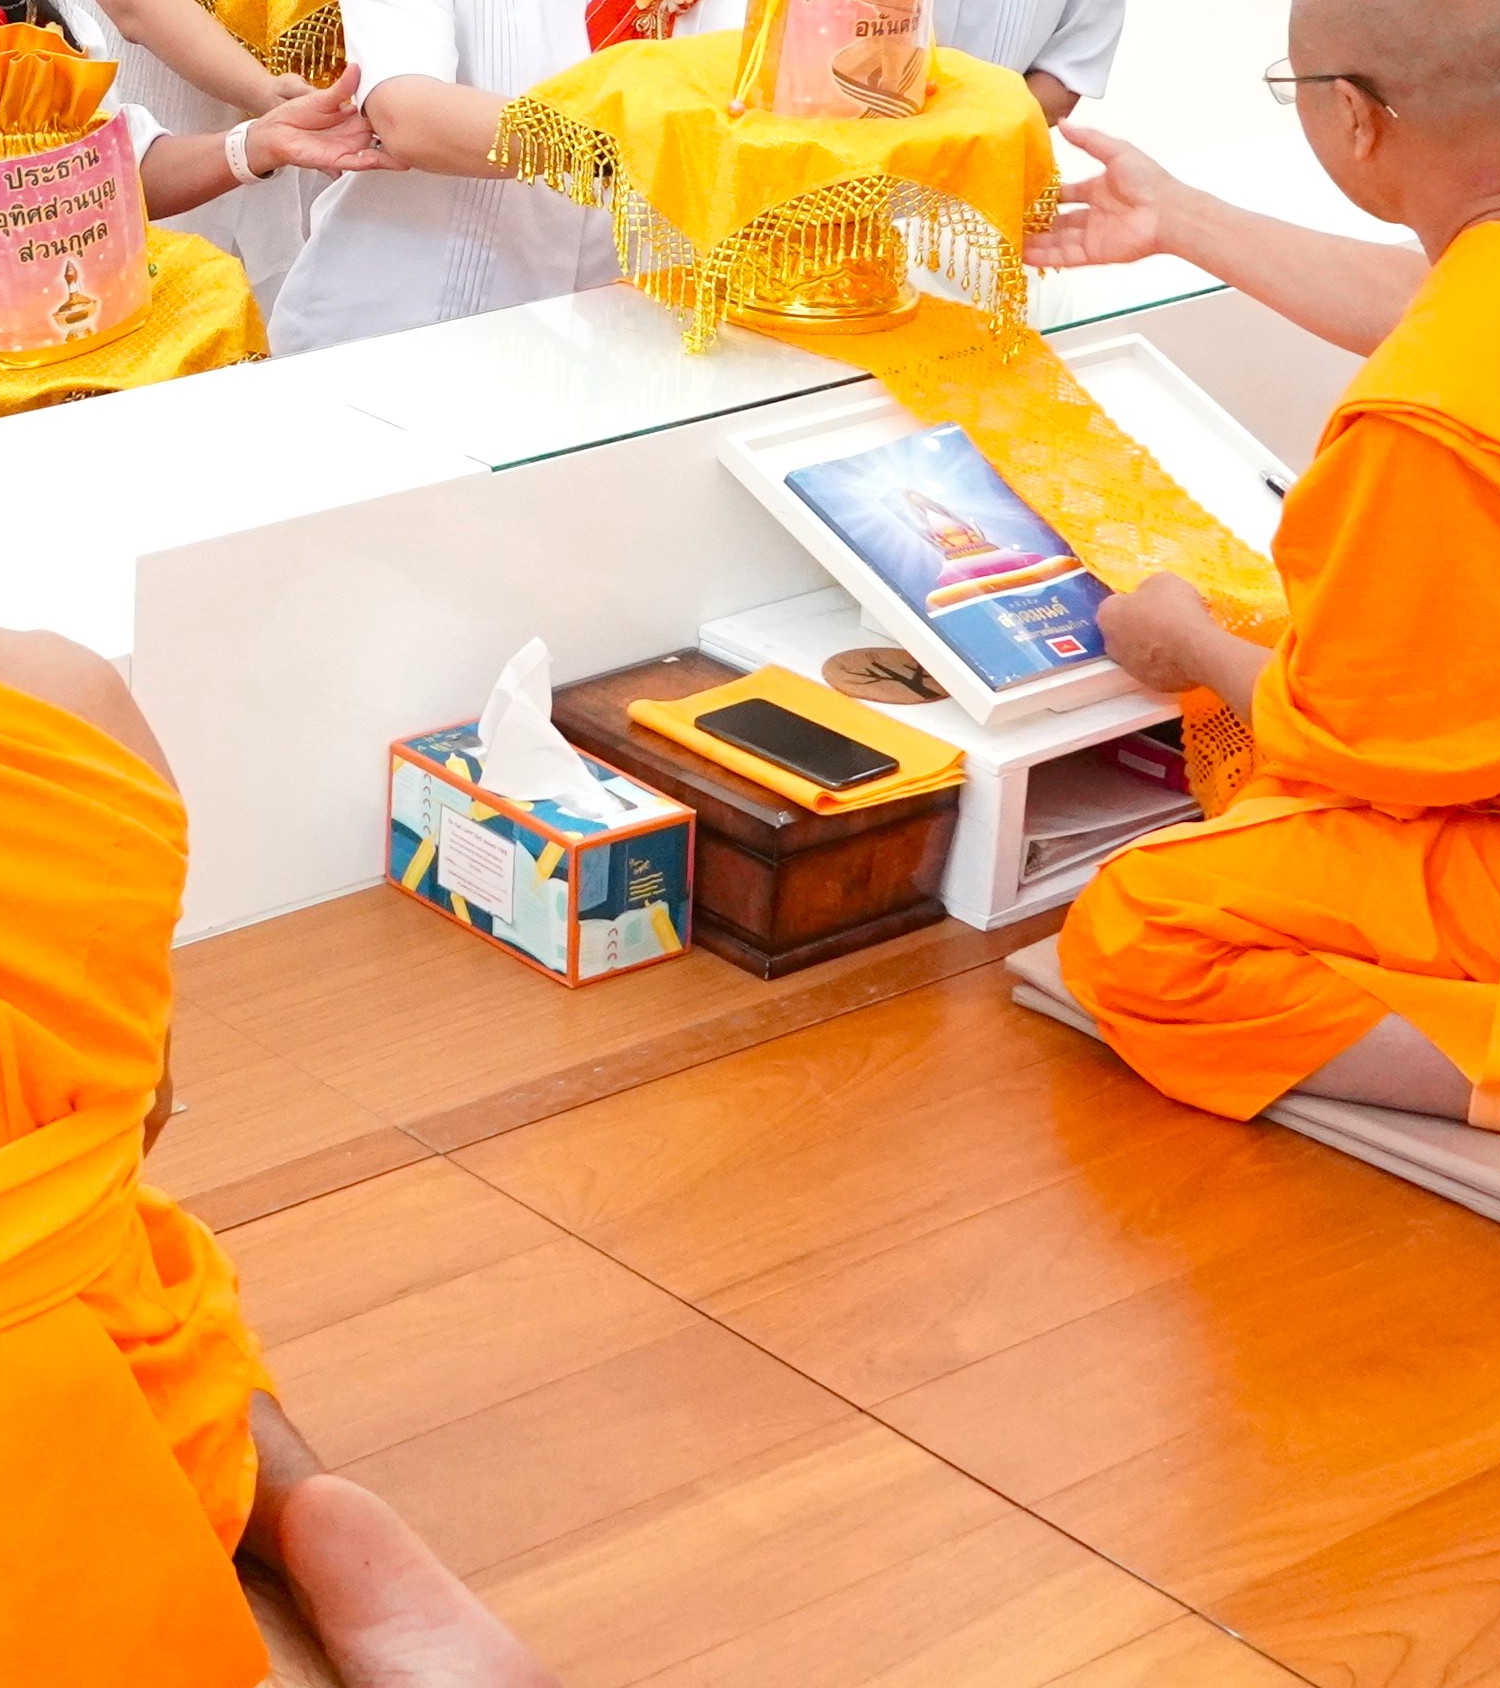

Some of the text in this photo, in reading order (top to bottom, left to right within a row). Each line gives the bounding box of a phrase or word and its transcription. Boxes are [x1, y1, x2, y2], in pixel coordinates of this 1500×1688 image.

[3, 147, 100, 190] ประธาน
[18, 222, 109, 263] ส่วนกุศล
